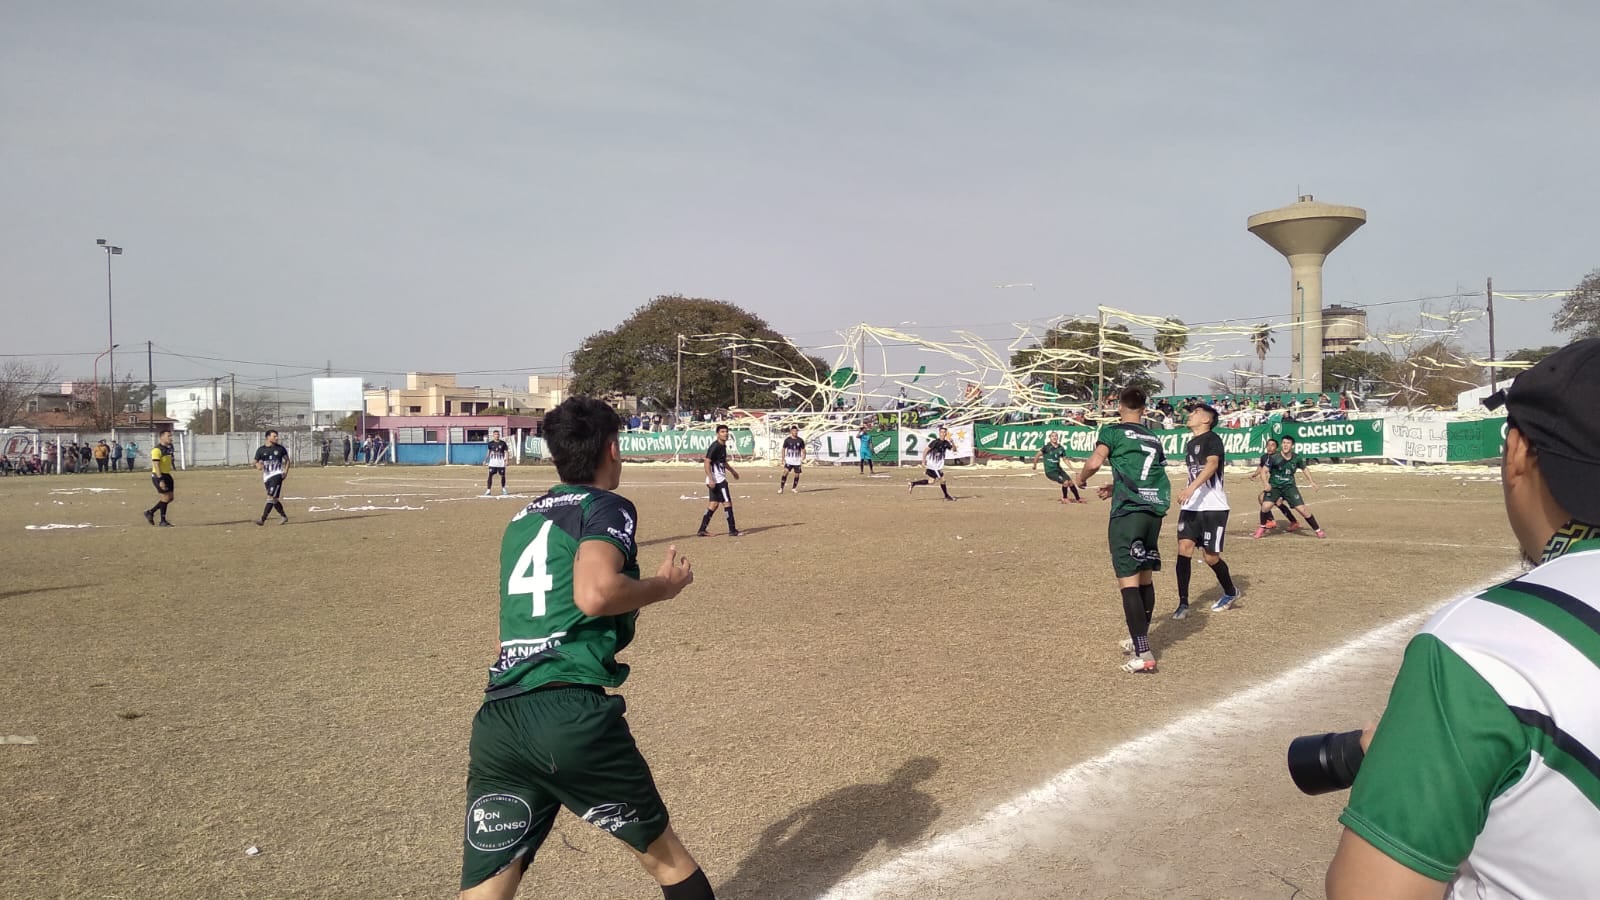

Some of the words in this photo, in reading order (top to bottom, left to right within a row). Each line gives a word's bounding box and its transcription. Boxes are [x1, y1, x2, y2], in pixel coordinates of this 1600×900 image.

[1298, 424, 1355, 438] CACHITO
[631, 436, 646, 452] NO
[647, 435, 672, 451] PASA
[674, 436, 689, 450] DE
[1003, 431, 1018, 450] LA
[1295, 440, 1363, 454] PRESENTE
[1141, 444, 1157, 480] 7
[1204, 531, 1212, 540] 10
[507, 519, 554, 617] 4
